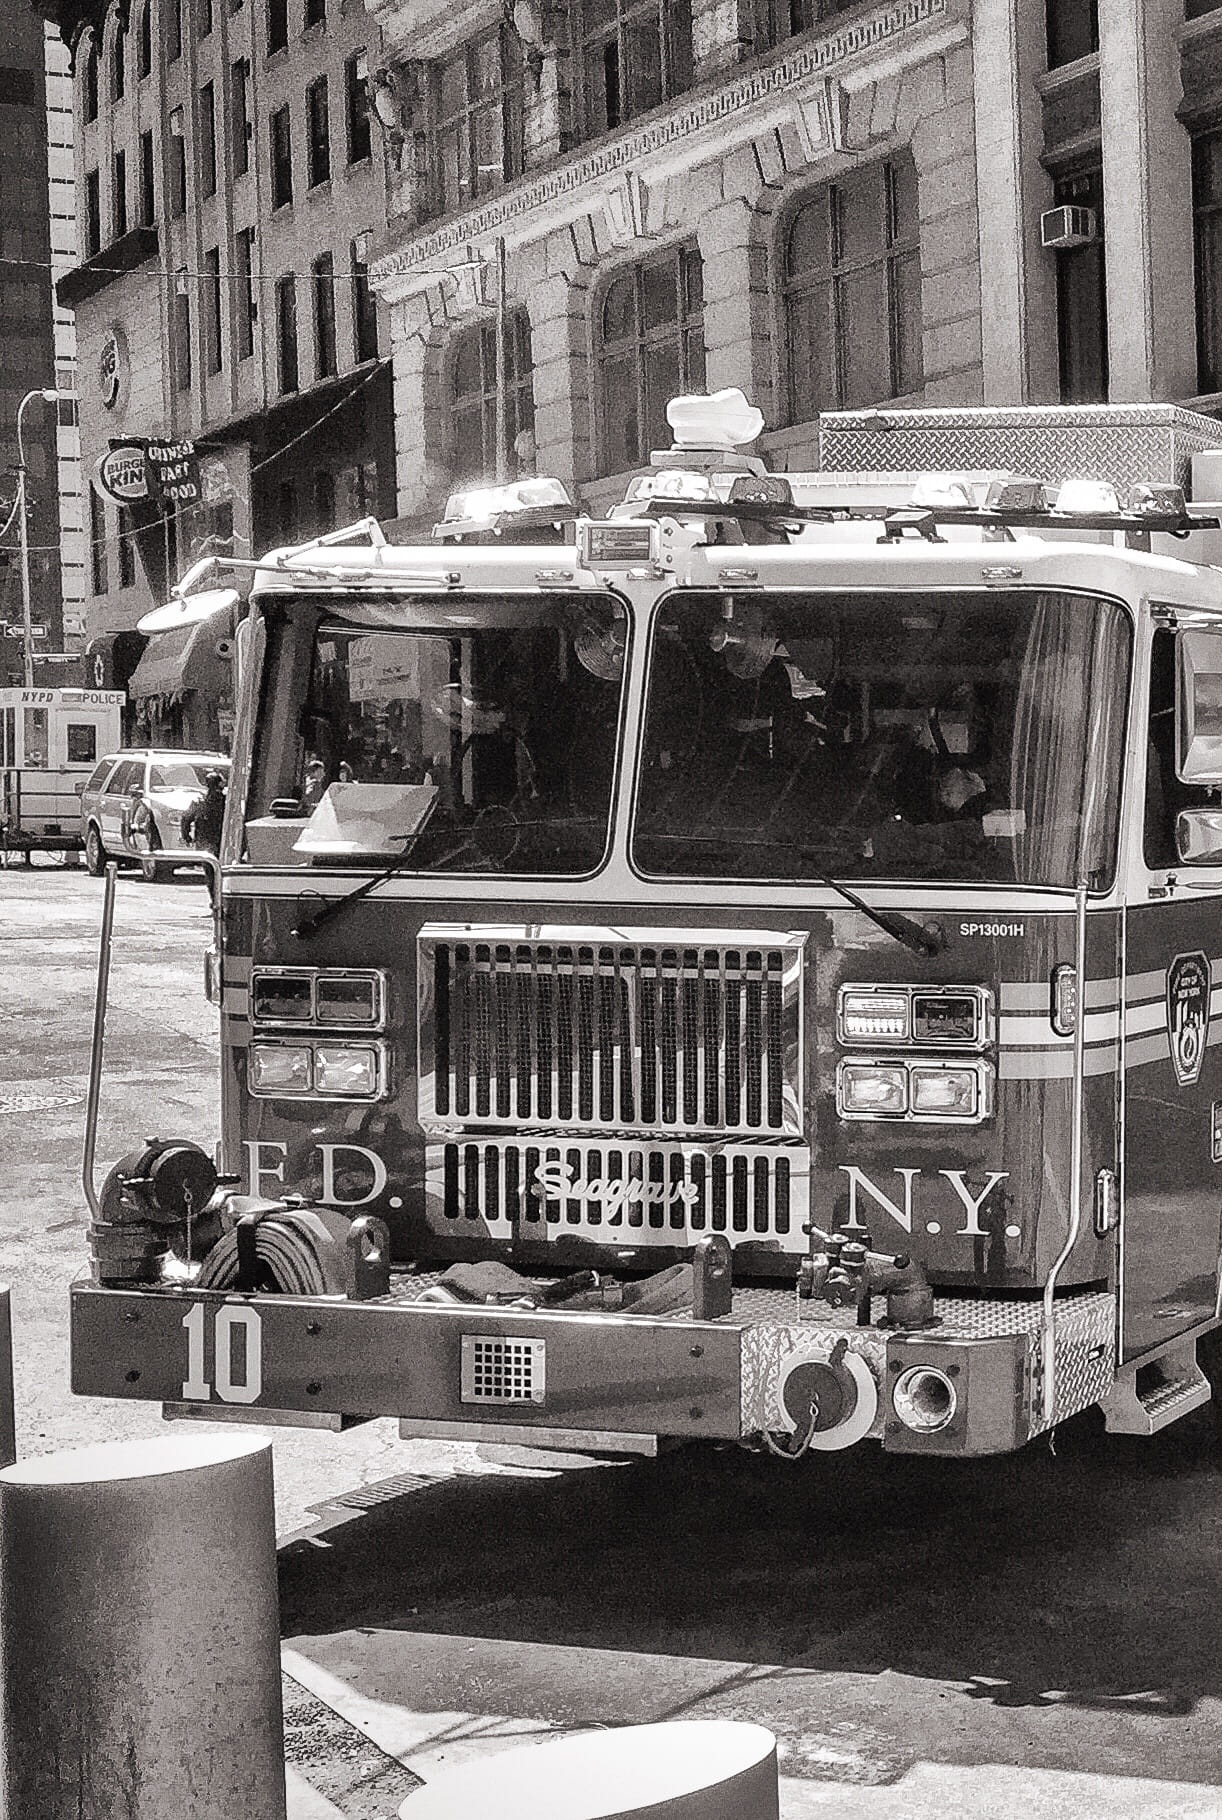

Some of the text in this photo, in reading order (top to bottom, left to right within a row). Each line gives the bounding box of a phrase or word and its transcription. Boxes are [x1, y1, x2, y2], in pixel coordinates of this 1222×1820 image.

[109, 468, 144, 490] KIN
[21, 691, 54, 702] NYPD
[82, 692, 124, 705] POLICE
[960, 923, 1024, 937] SP13001H
[534, 1160, 700, 1221] Seagrave
[838, 1165, 1021, 1238] N.Y.
[182, 1302, 262, 1404] 10
